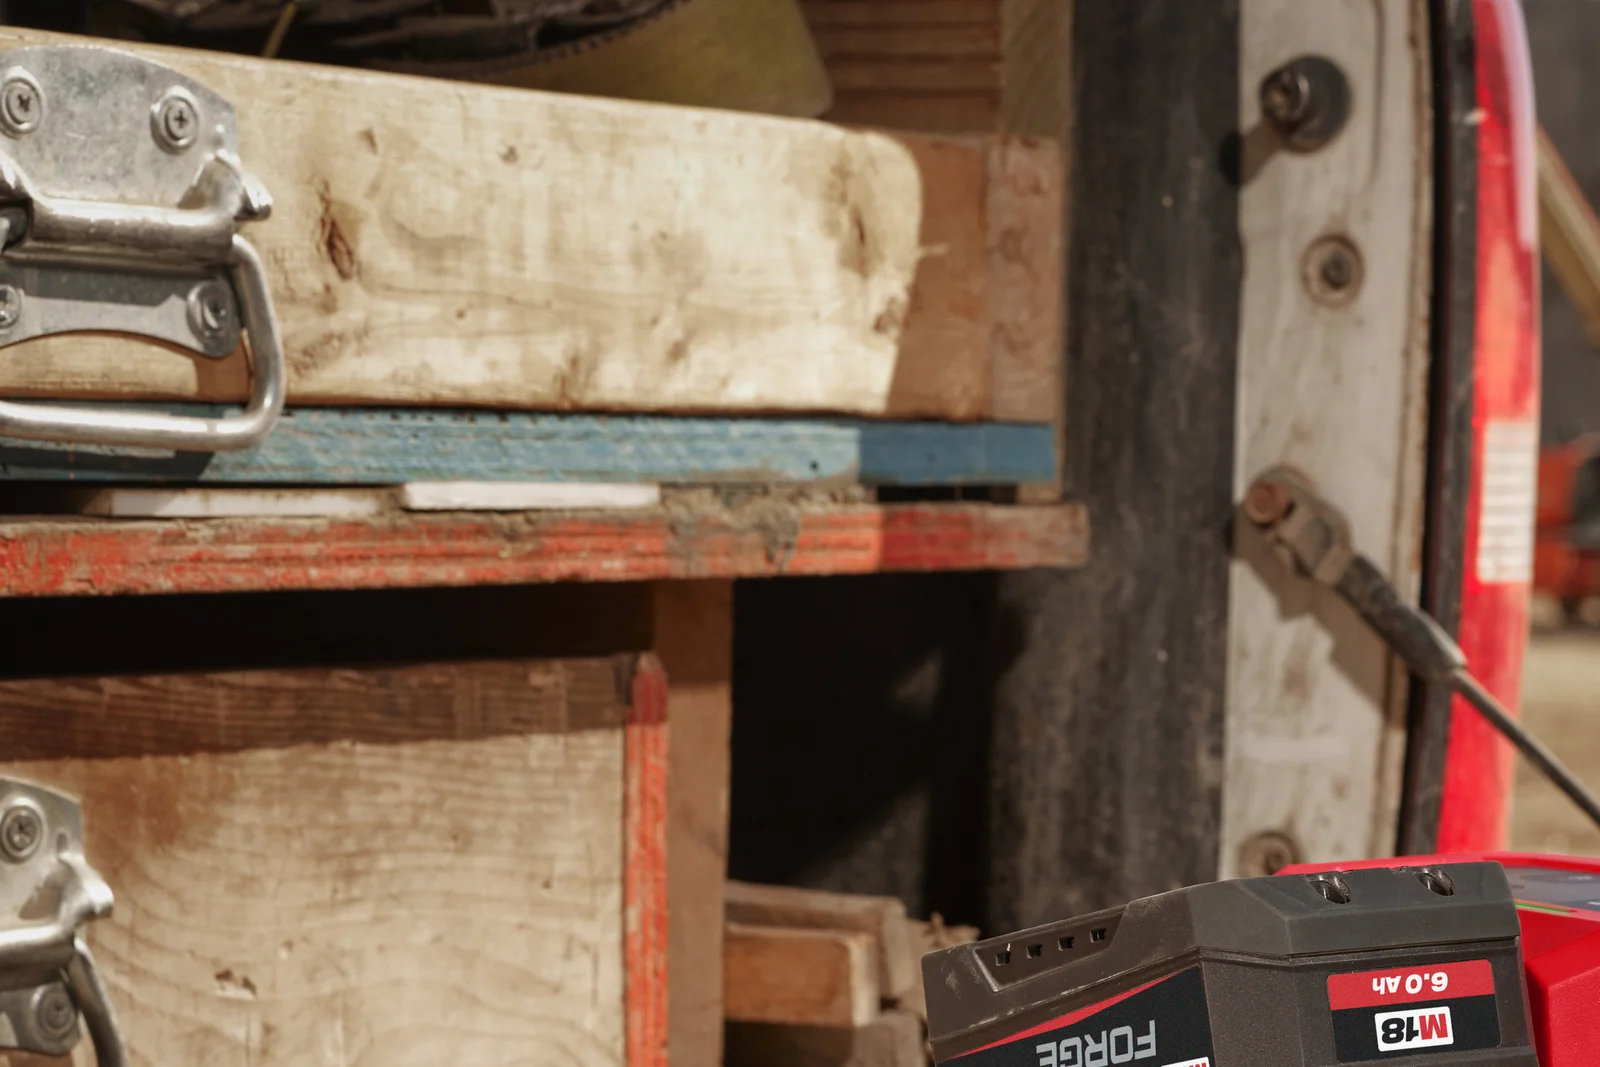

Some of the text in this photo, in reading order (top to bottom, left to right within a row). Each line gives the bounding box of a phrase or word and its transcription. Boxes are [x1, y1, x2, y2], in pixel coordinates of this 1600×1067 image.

[1372, 972, 1449, 995] 6.0 Ah
[1381, 1013, 1449, 1044] M18
